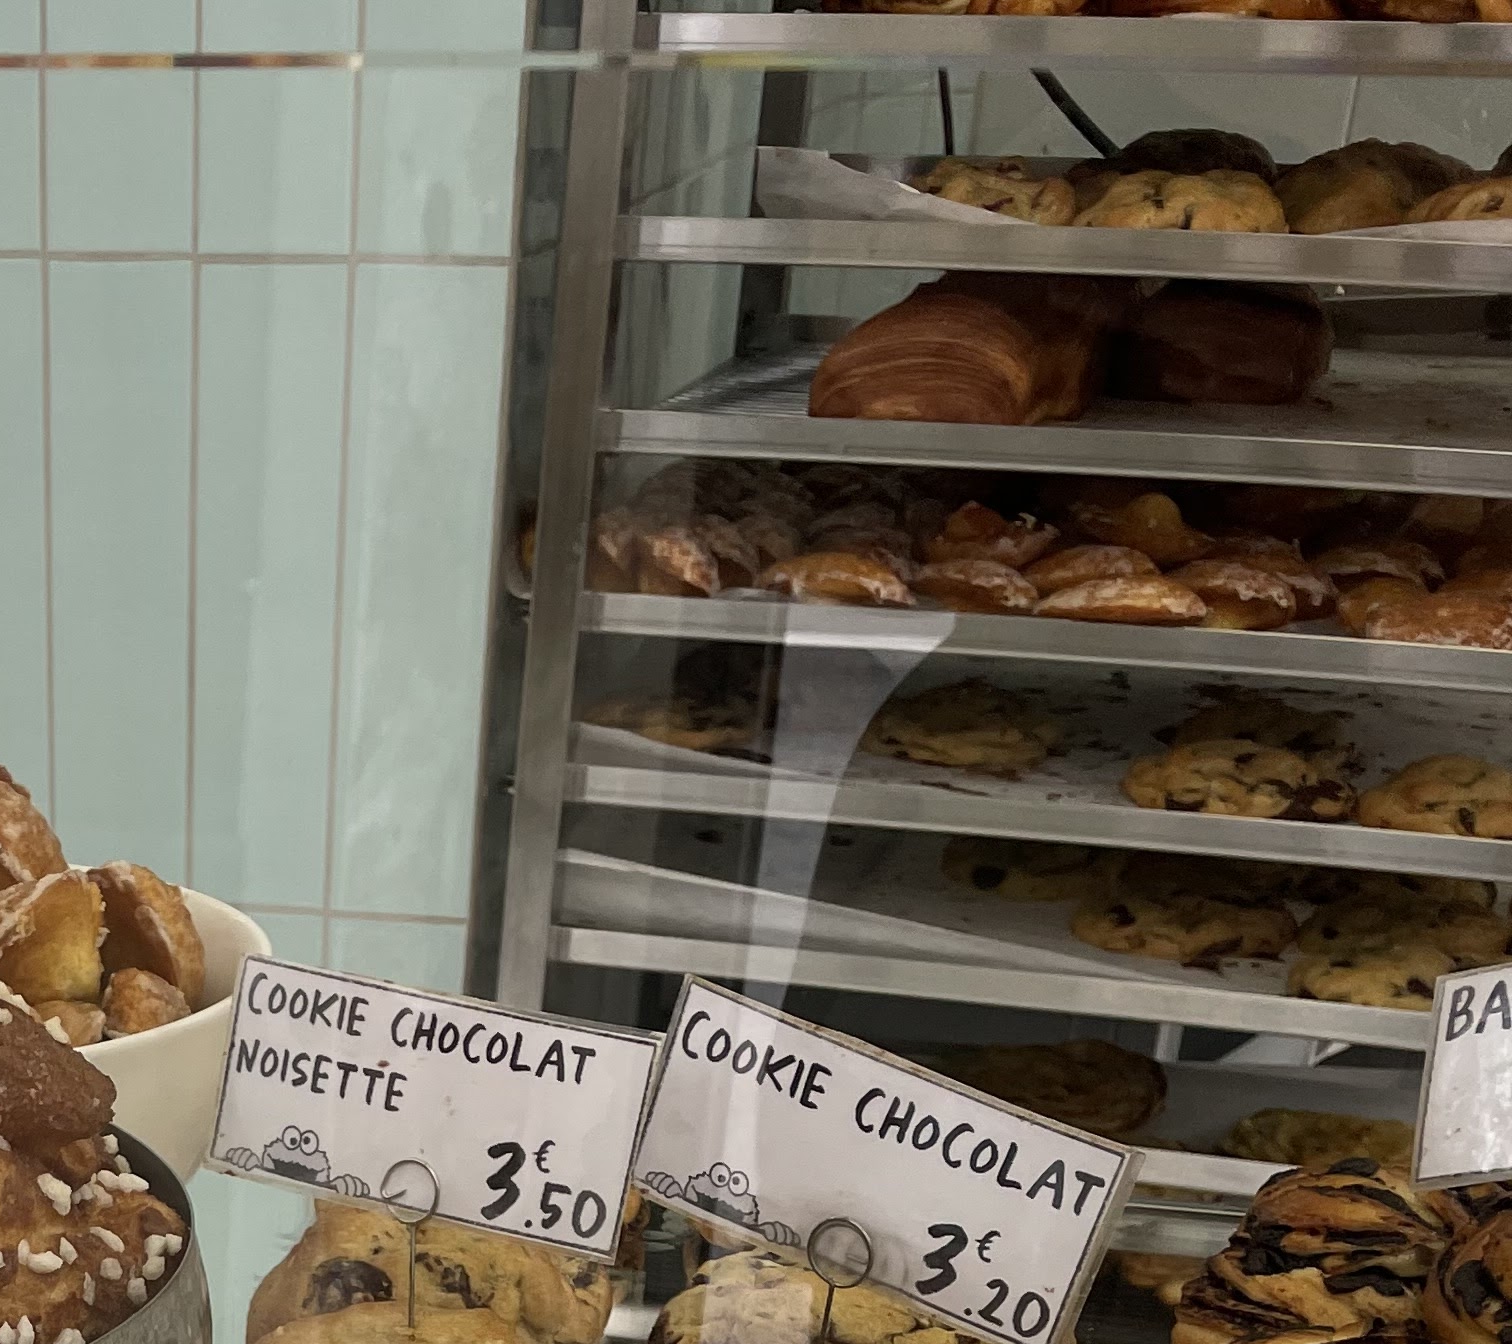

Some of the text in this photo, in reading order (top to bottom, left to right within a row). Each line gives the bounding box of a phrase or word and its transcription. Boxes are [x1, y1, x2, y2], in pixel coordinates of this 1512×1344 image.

[235, 1038, 409, 1112] NOISETTE
[248, 972, 596, 1085] COOKIE CHOCOLAT
[681, 1010, 1106, 1217] COOKIE CHOCOLAT
